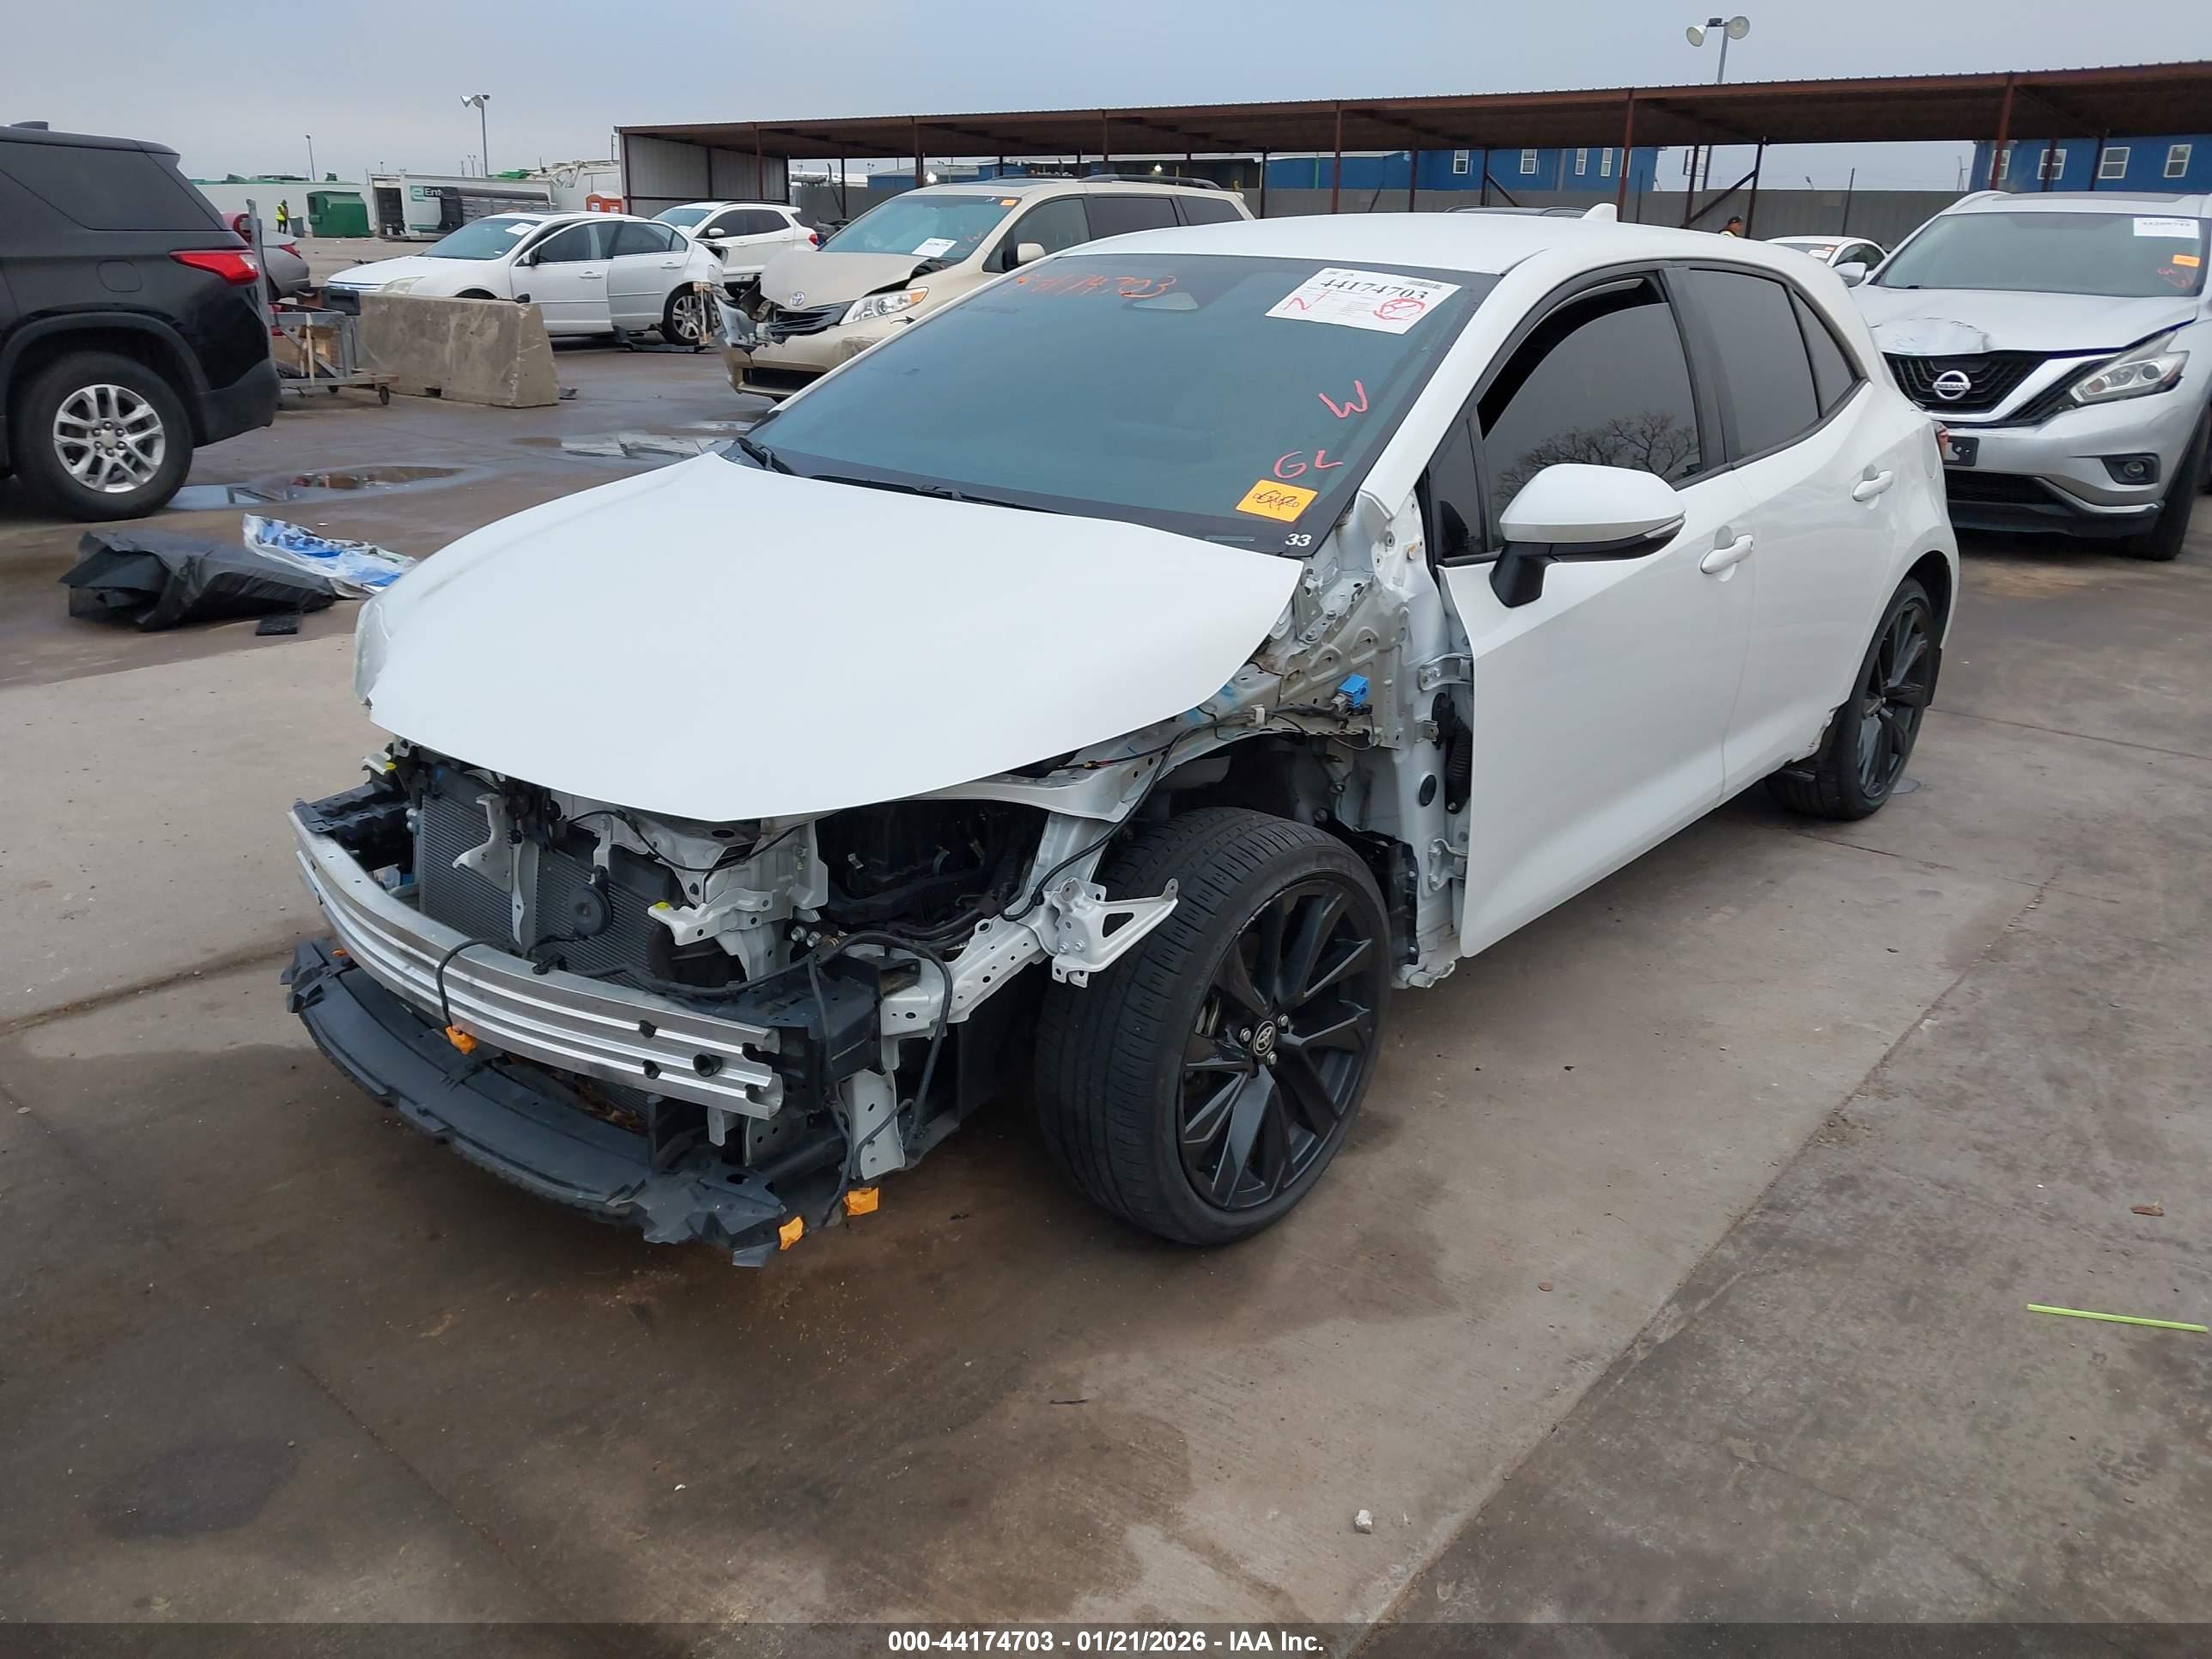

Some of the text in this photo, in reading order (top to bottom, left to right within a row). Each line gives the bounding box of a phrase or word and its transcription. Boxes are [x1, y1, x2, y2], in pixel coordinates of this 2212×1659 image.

[1319, 277, 1429, 300] 44174703
[1318, 380, 1369, 419] W
[1285, 533, 1312, 547] 33
